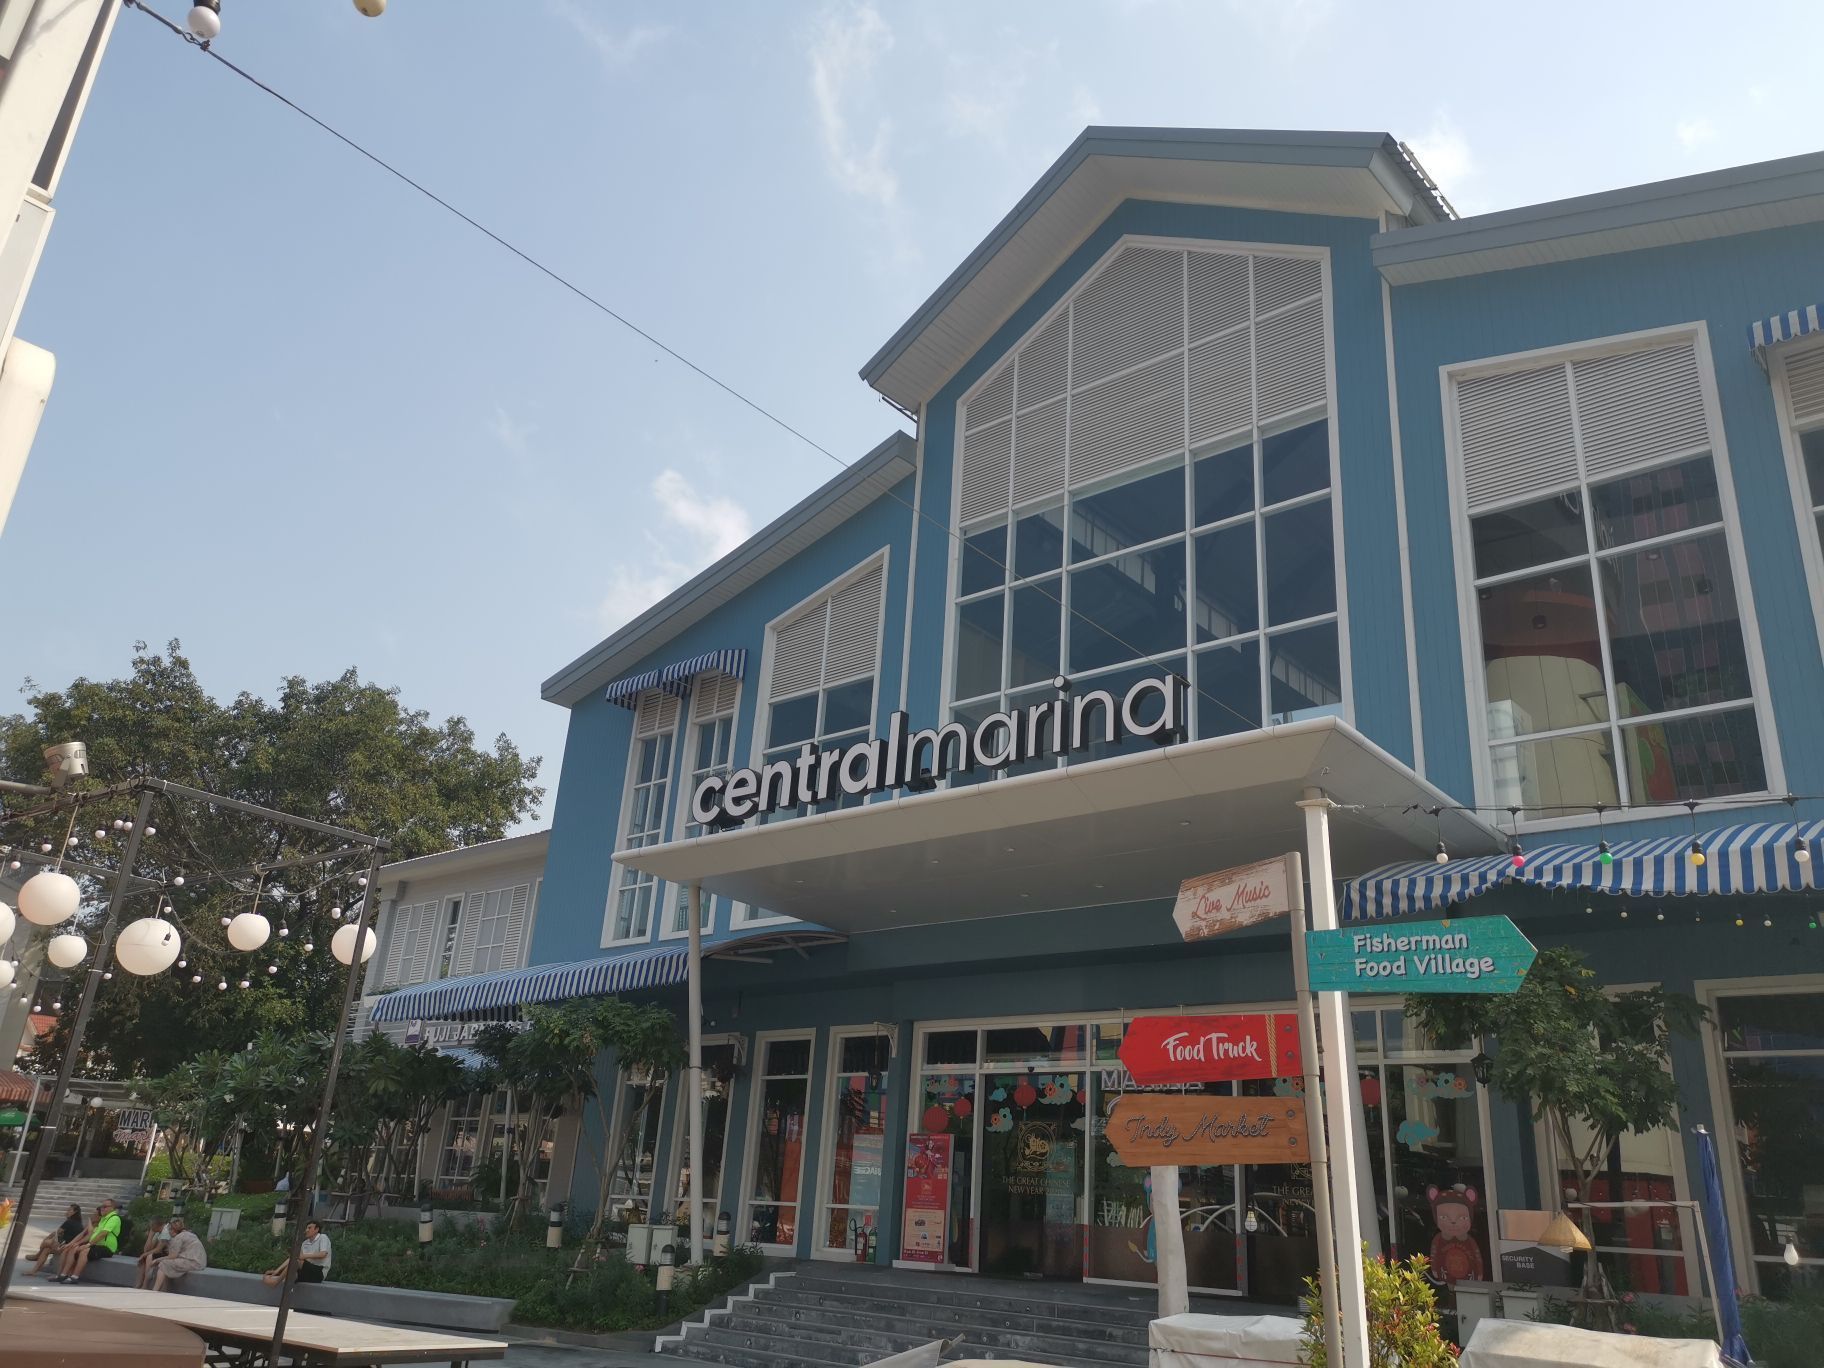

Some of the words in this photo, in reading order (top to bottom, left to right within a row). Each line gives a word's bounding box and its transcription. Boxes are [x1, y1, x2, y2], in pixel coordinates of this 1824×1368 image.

[692, 674, 1187, 826] centralmarina
[1191, 894, 1222, 920] Live
[1226, 881, 1271, 912] Music
[1353, 932, 1468, 953] Fisherman
[1354, 955, 1406, 977] Food
[1413, 953, 1495, 979] Village
[1161, 1032, 1205, 1062] Food
[1205, 1032, 1262, 1062] Truck
[1125, 1114, 1180, 1147] Indy
[1182, 1112, 1275, 1143] Market
[1272, 1185, 1290, 1195] THE
[1292, 1186, 1312, 1196] GRE
[1502, 1255, 1534, 1263] SECURITY
